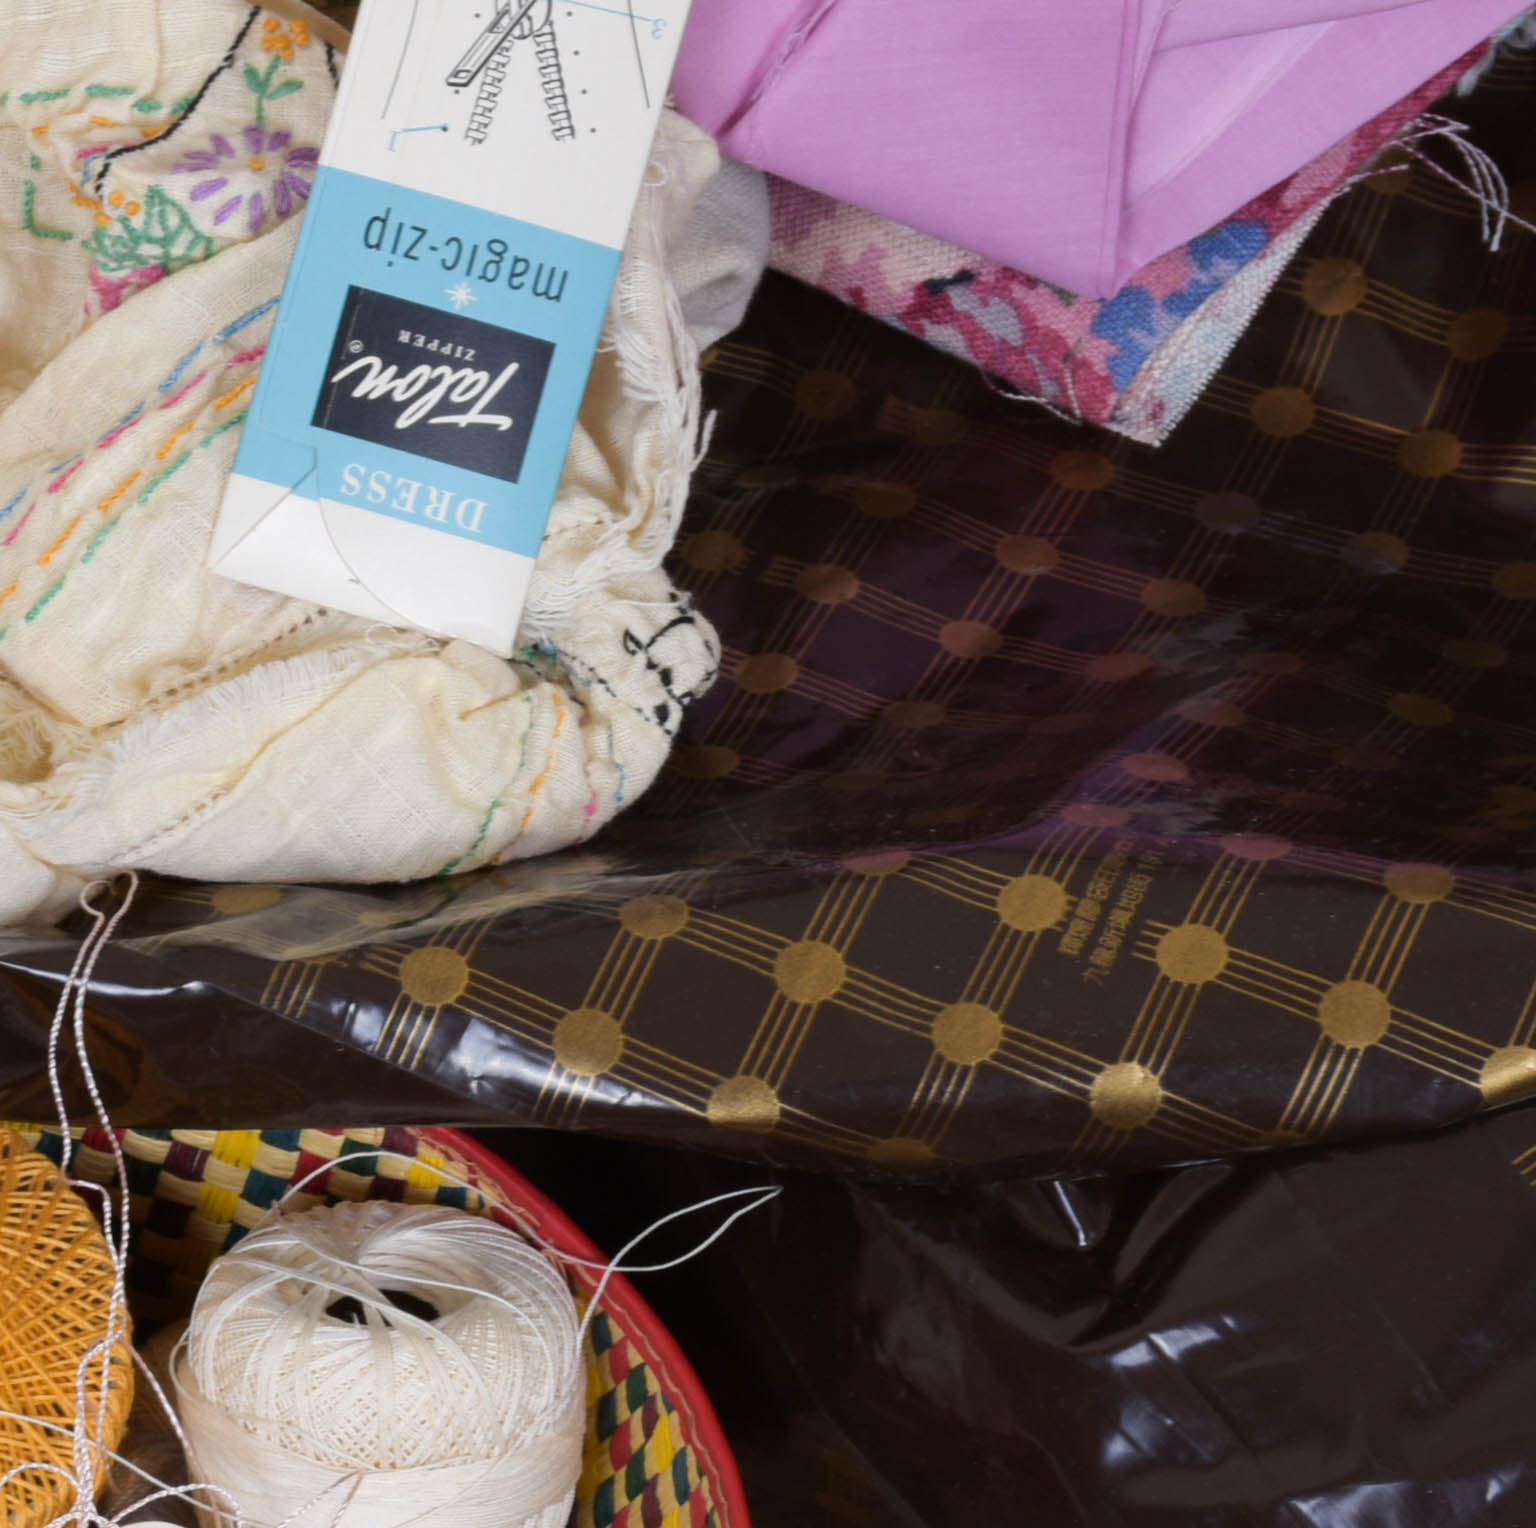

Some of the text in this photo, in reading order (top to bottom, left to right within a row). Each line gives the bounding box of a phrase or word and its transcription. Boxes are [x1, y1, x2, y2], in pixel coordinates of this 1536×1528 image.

[362, 206, 569, 302] magic-zip
[397, 328, 478, 361] ZIPPER
[330, 355, 520, 431] Talon
[339, 462, 489, 534] DRESS
